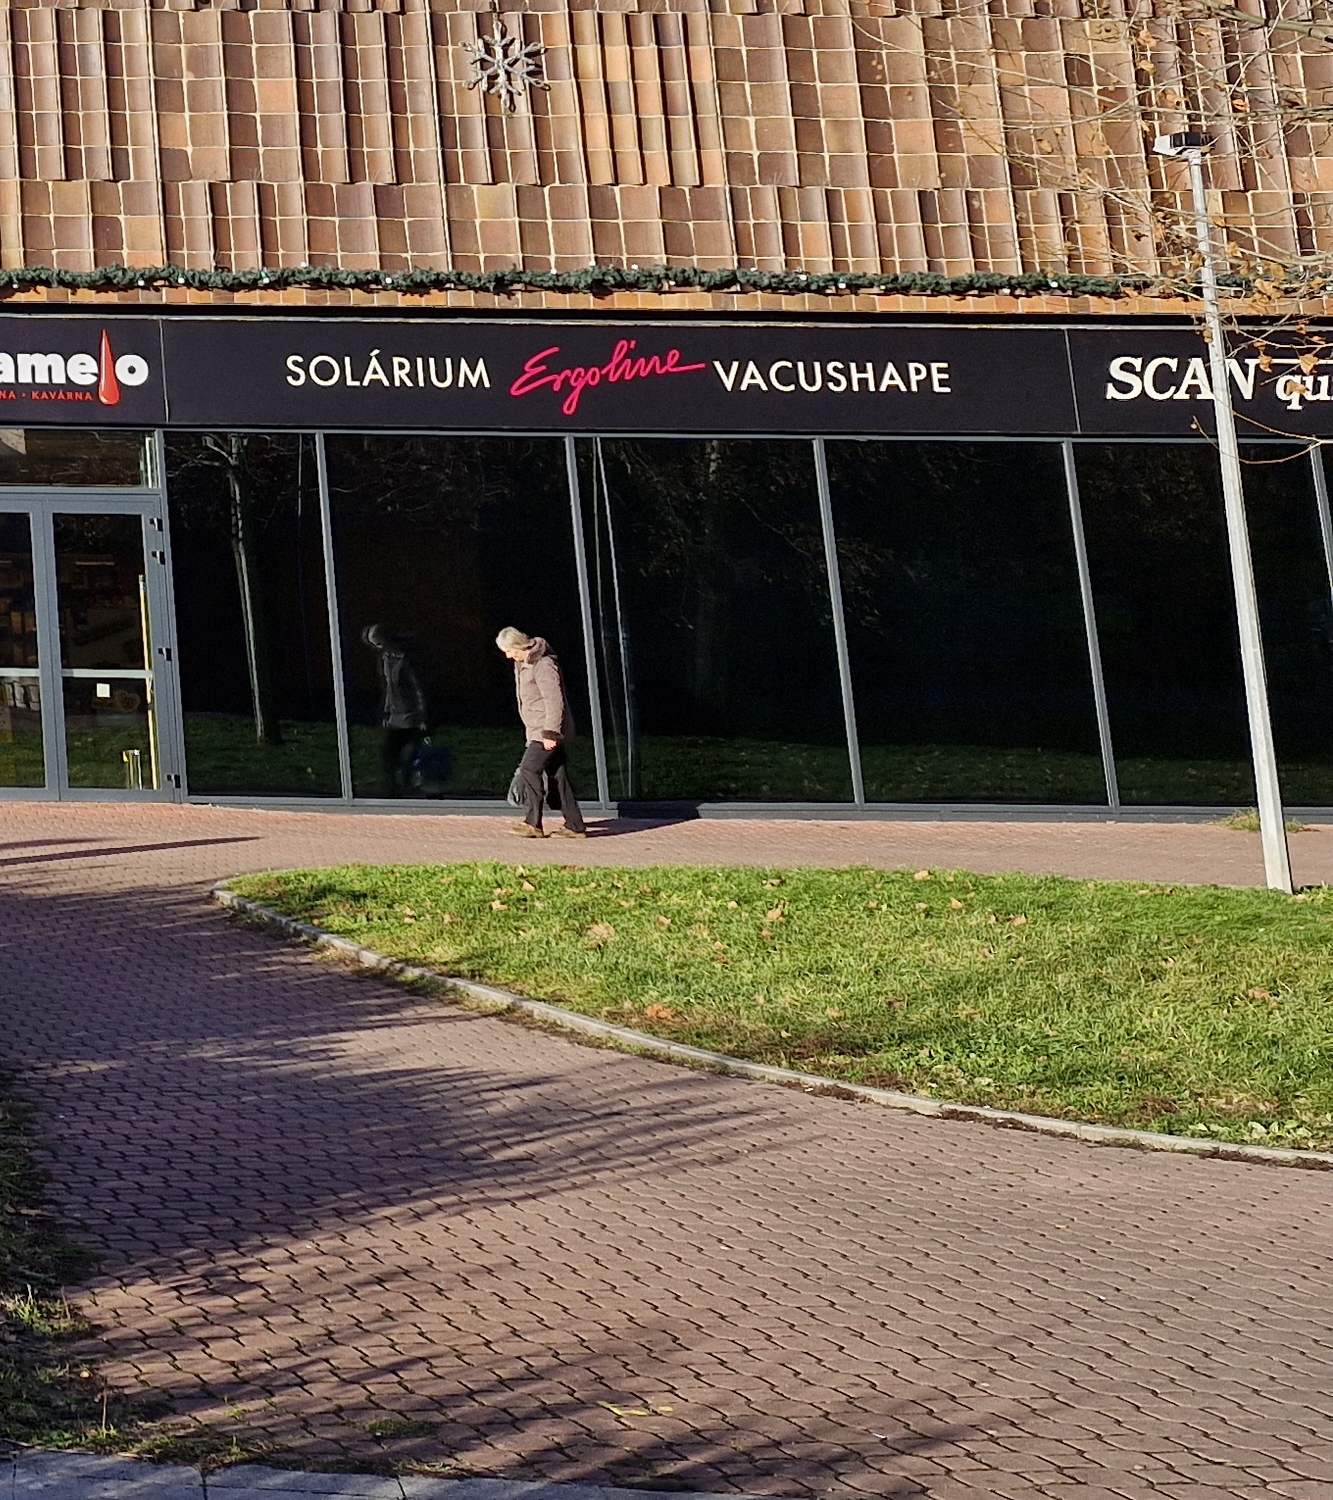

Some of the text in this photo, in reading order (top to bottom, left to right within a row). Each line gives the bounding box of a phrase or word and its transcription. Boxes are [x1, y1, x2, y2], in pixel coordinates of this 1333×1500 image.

[31, 389, 93, 401] KAVÁRNA
[285, 340, 952, 415] SOLÁRIUM Ergoline VACUSHAPE
[1276, 374, 1333, 410] qu
